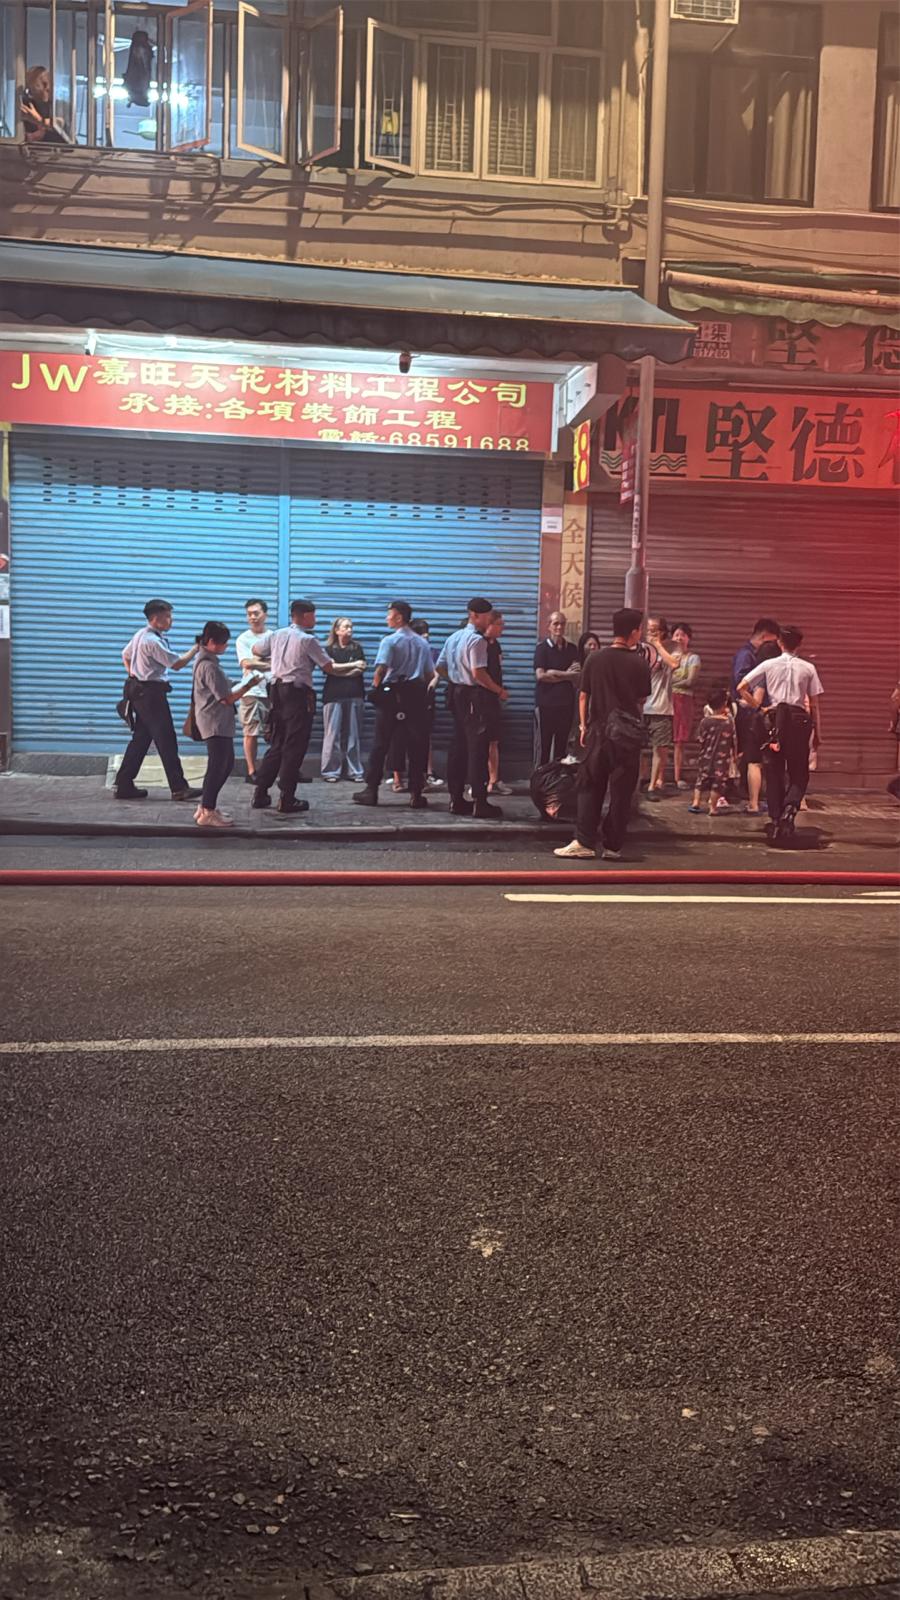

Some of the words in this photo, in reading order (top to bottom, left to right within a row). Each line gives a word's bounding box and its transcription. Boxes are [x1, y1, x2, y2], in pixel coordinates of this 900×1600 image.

[12, 353, 89, 393] JW
[93, 358, 527, 408] 嘉旺天花材料工程公司
[700, 401, 900, 485] 堅德
